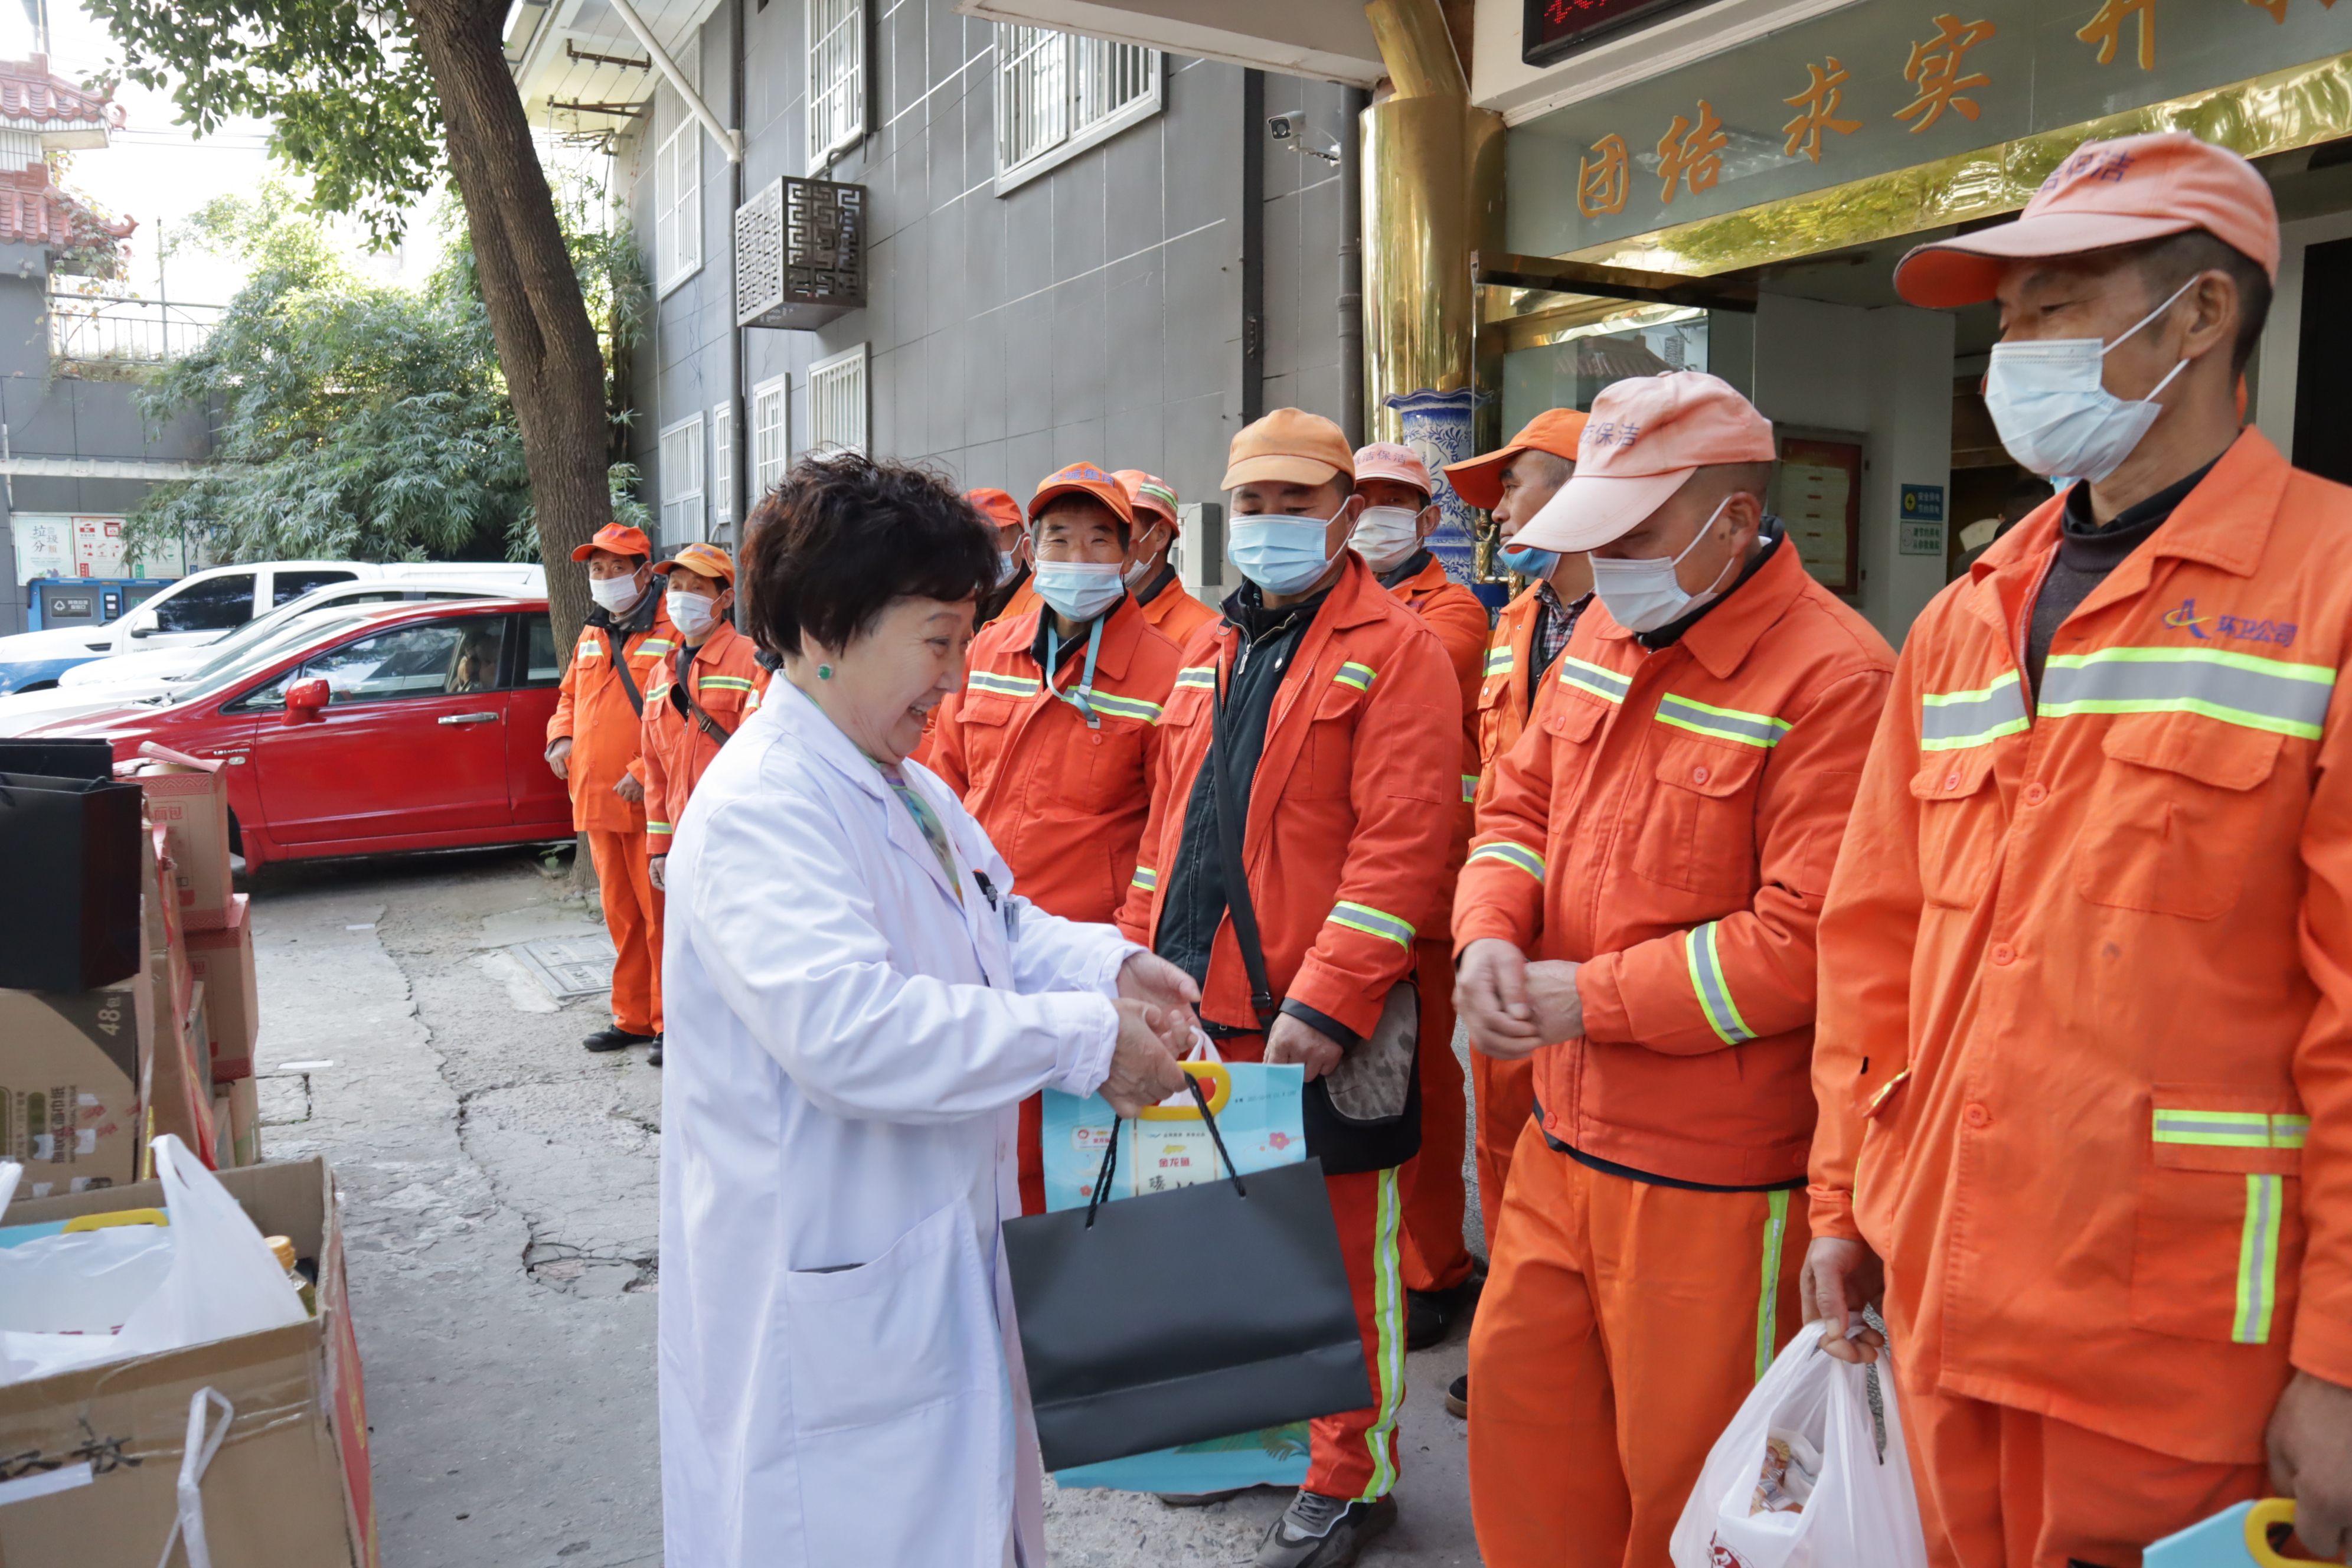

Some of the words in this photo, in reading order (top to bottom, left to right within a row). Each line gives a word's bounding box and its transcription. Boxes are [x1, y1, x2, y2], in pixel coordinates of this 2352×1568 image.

[1577, 0, 2338, 218] 团结求实开
[2216, 615, 2298, 647] 环卫公司
[1159, 1157, 1190, 1168] 金龙鱼
